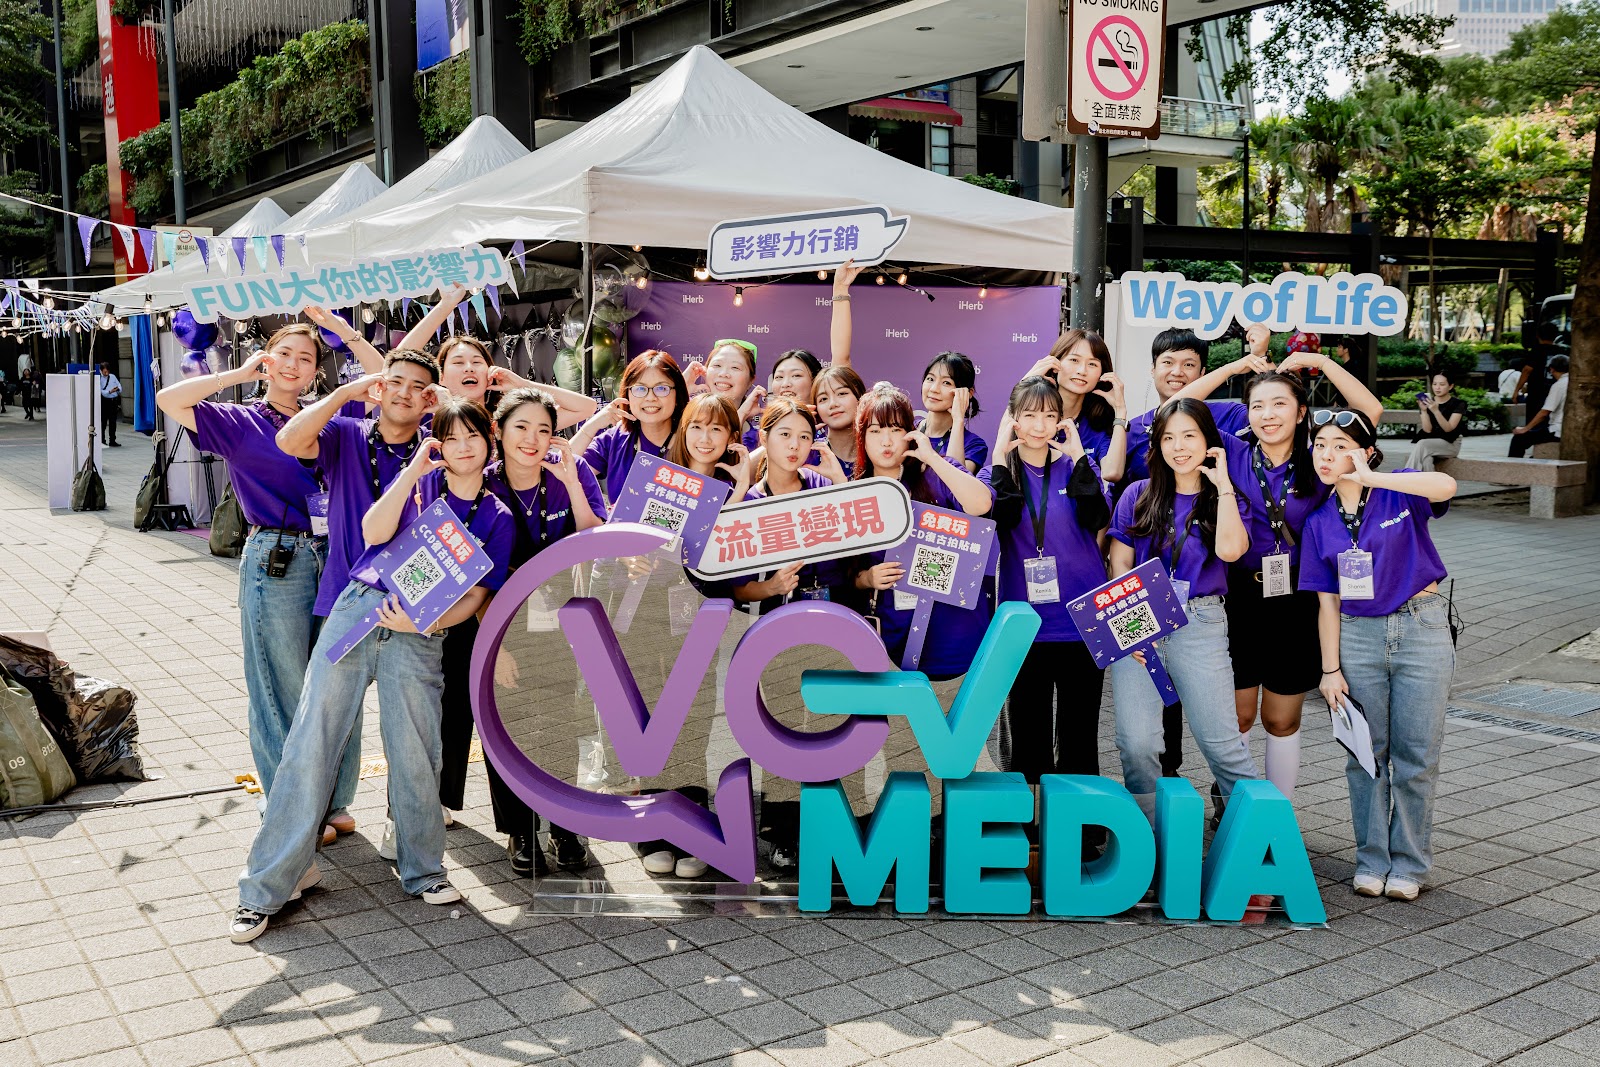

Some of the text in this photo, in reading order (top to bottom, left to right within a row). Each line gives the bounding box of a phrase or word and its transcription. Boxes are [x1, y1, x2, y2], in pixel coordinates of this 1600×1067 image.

[1091, 102, 1142, 121] 全面禁菸
[730, 225, 860, 262] 影響力行銷
[191, 248, 503, 317] FUN大你的影響力
[682, 295, 704, 304] iHerb
[815, 297, 832, 307] iHer
[958, 301, 984, 311] iHerb
[1130, 280, 1398, 332] Way of Life
[640, 322, 662, 331] iHerb
[747, 325, 770, 334] iHerb
[885, 329, 910, 339] iHerb
[1012, 333, 1038, 343] iHerb
[682, 354, 704, 362] iHerb
[656, 467, 701, 495] 免費玩
[644, 482, 699, 511] 手作棉花糖
[714, 496, 885, 563] 流量變現
[921, 511, 968, 536] 免費玩
[437, 522, 473, 563] 免費玩
[910, 528, 982, 554] CD復古拍貼機
[418, 524, 468, 585] CCD復古拍貼機
[1095, 576, 1141, 609] 免費玩
[8, 756, 26, 769] 09
[798, 771, 1327, 925] MEDIA
